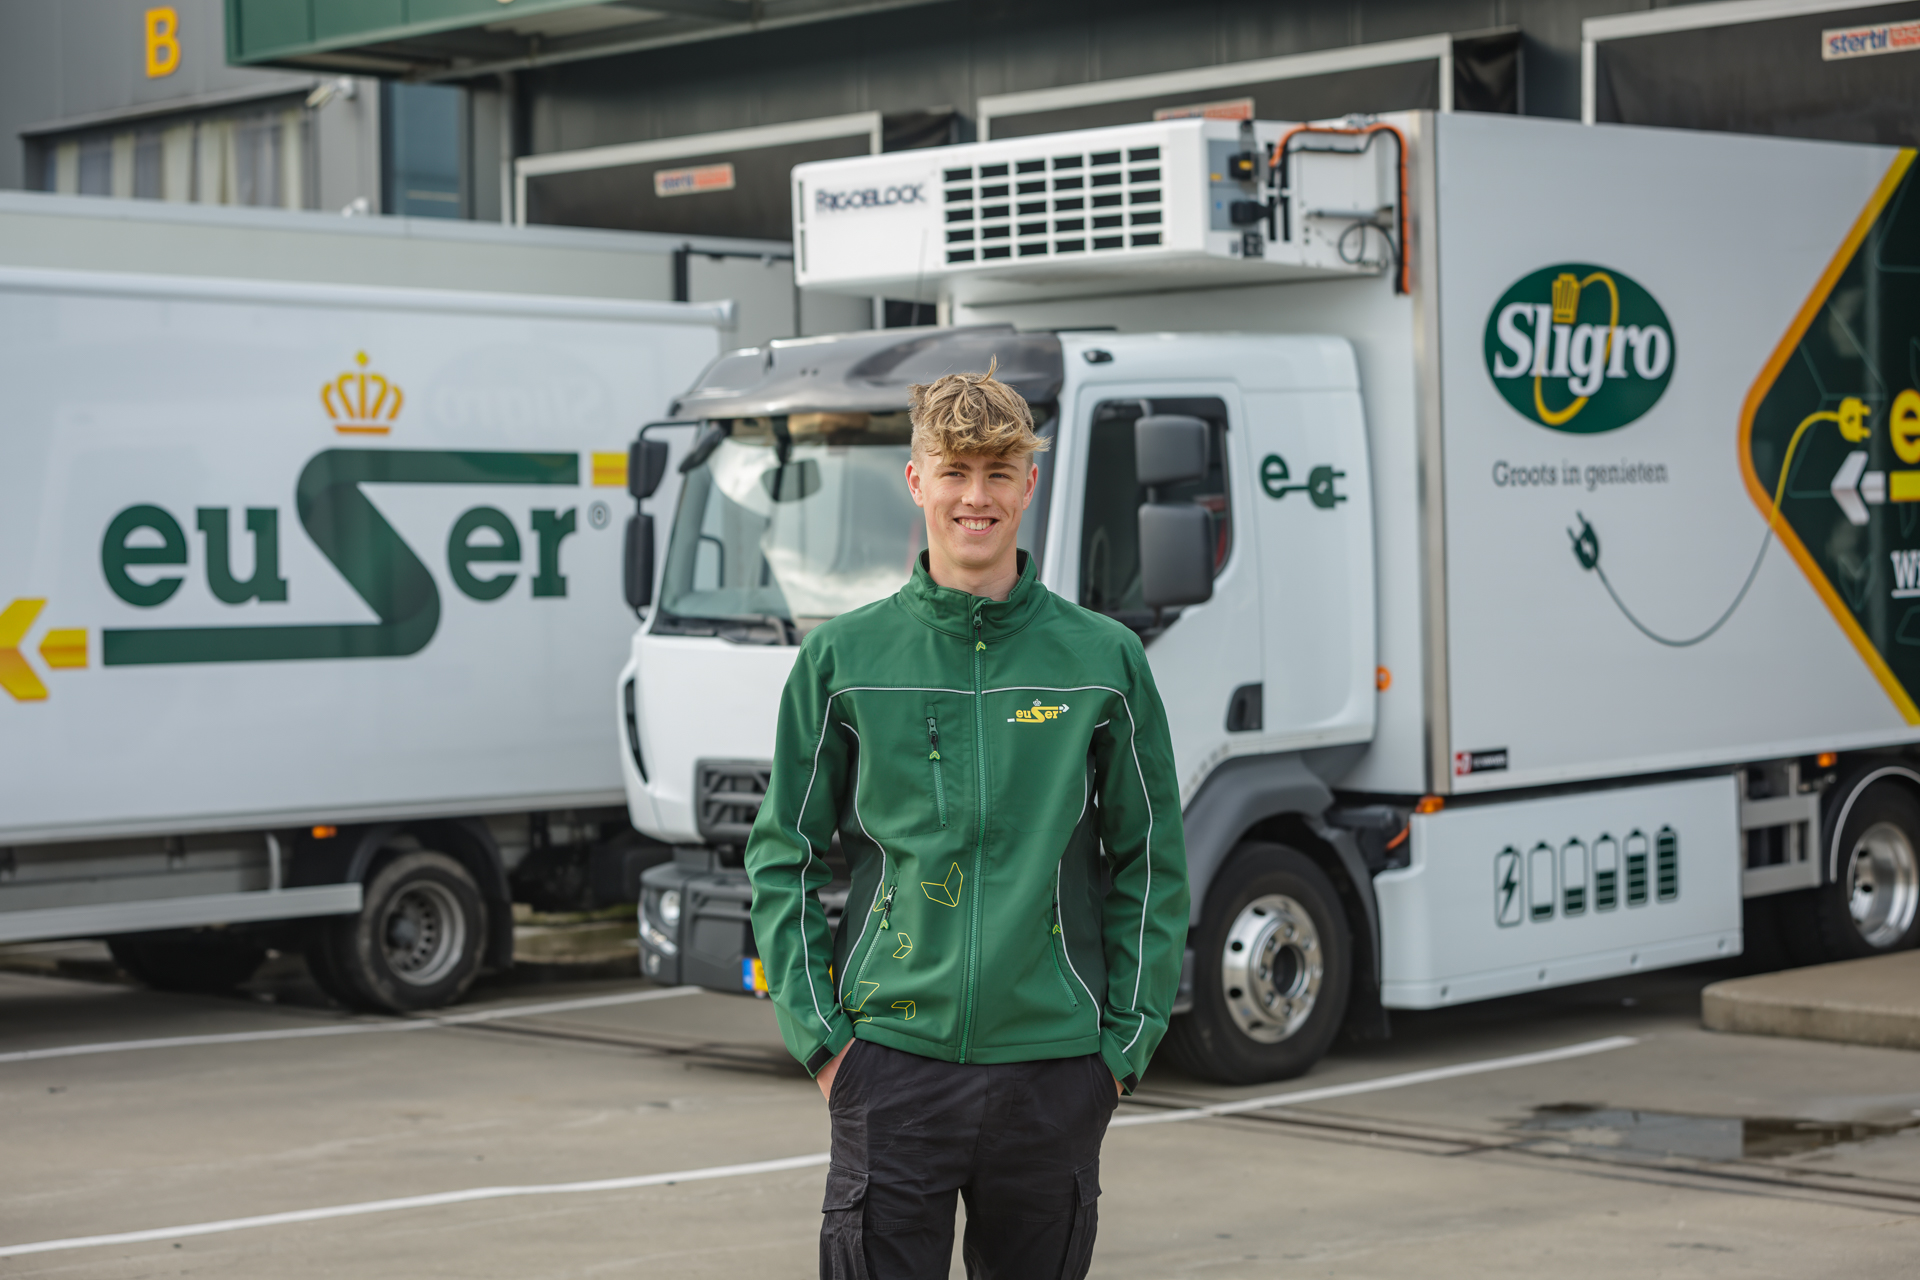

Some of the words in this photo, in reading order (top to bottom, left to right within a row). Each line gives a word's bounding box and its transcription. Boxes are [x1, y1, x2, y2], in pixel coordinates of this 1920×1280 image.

[146, 8, 181, 77] B
[1494, 302, 1671, 397] Sligro
[1492, 460, 1557, 487] Groots
[1562, 458, 1581, 486] in
[1584, 457, 1668, 492] genieten
